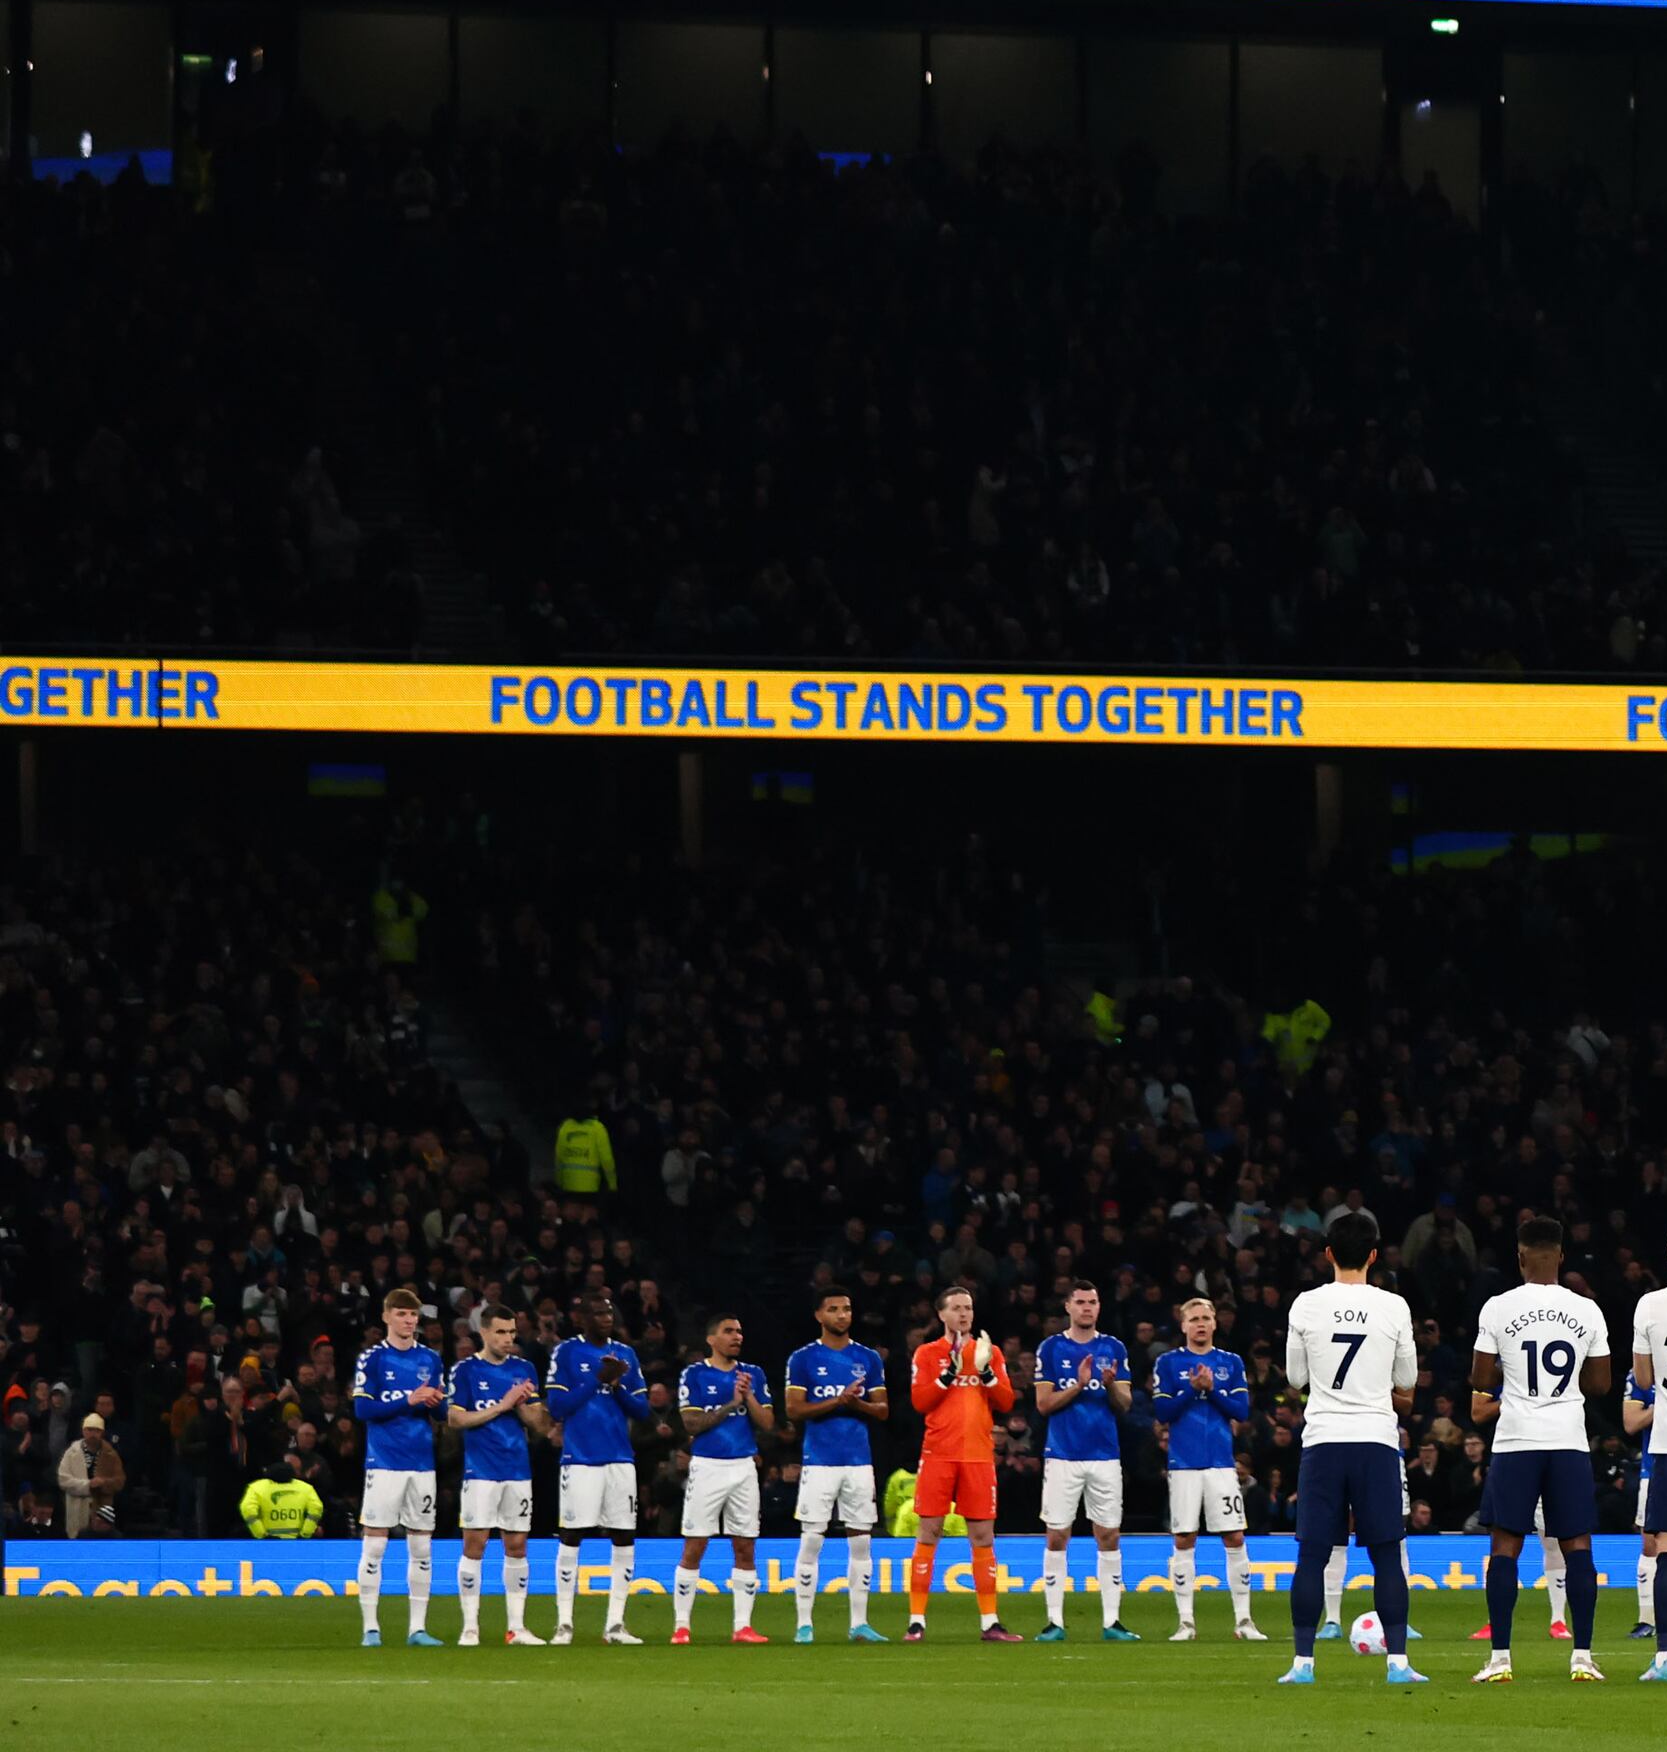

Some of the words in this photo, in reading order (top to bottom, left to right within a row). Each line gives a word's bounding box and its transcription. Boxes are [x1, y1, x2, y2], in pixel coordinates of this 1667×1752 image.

[0, 667, 217, 718] GETHER
[492, 678, 774, 728] FOOTBALL
[791, 682, 1006, 731] STANDS
[1023, 686, 1302, 736] TOGETHER
[1333, 1310, 1368, 1325] SON
[1504, 1309, 1588, 1339] SESSEGNON
[1331, 1333, 1368, 1390] 7
[1520, 1340, 1577, 1397] 19
[1222, 1496, 1244, 1516] 30
